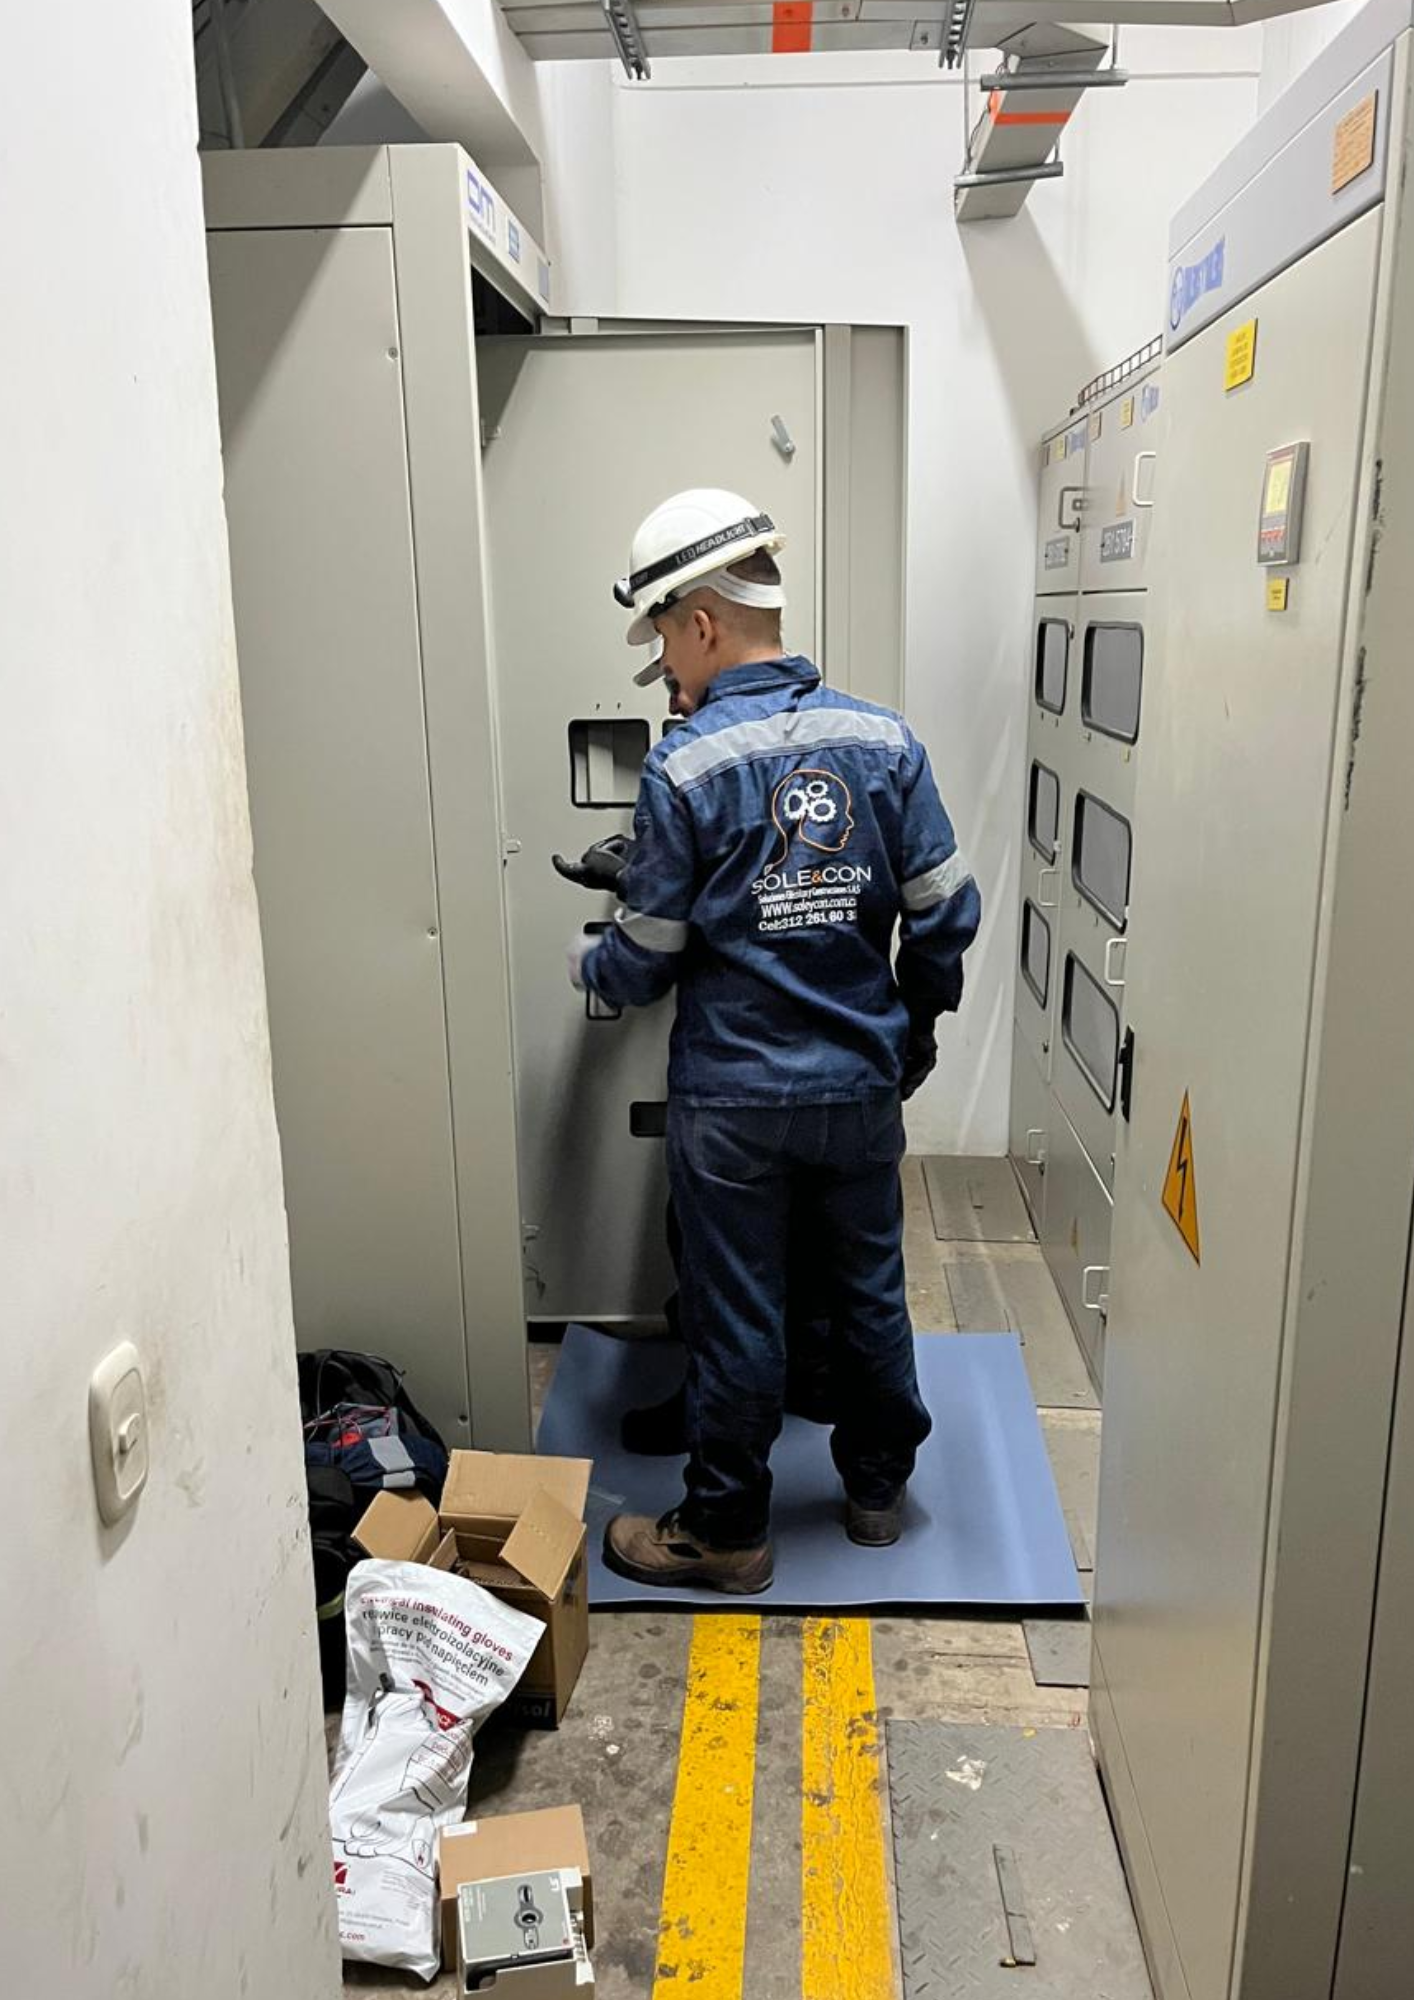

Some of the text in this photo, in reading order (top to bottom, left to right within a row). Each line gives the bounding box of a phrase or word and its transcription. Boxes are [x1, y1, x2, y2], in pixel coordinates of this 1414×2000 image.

[751, 866, 871, 894] SOLE&CON
[805, 911, 828, 924] 261
[412, 1597, 472, 1639] insulating
[472, 1631, 514, 1662] gloves
